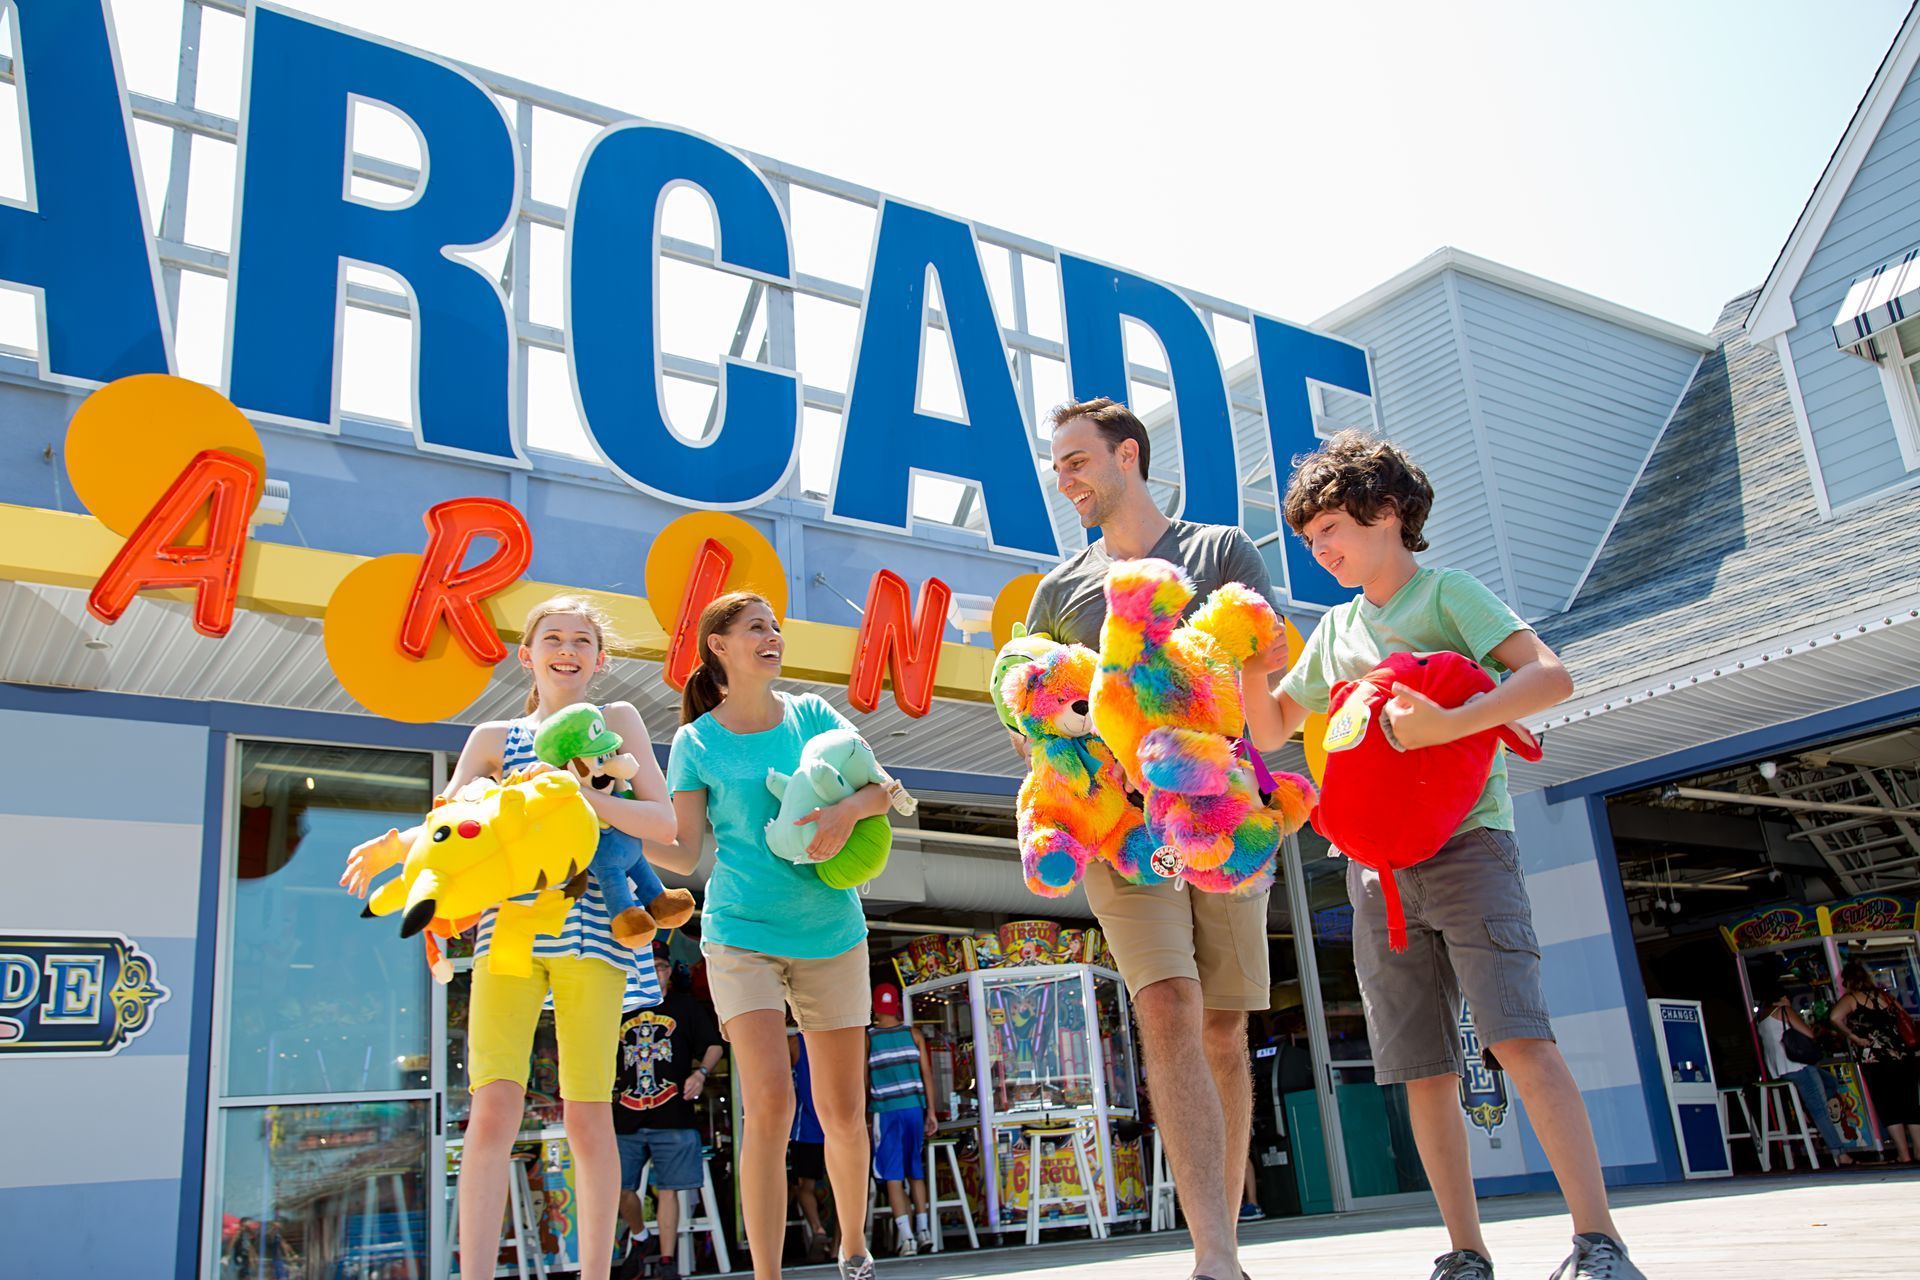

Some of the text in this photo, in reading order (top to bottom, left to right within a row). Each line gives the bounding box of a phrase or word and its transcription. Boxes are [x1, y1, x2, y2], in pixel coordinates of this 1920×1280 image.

[592, 723, 602, 735] L
[1000, 923, 1057, 946] CIRCUS
[1661, 1009, 1694, 1021] CHANGE
